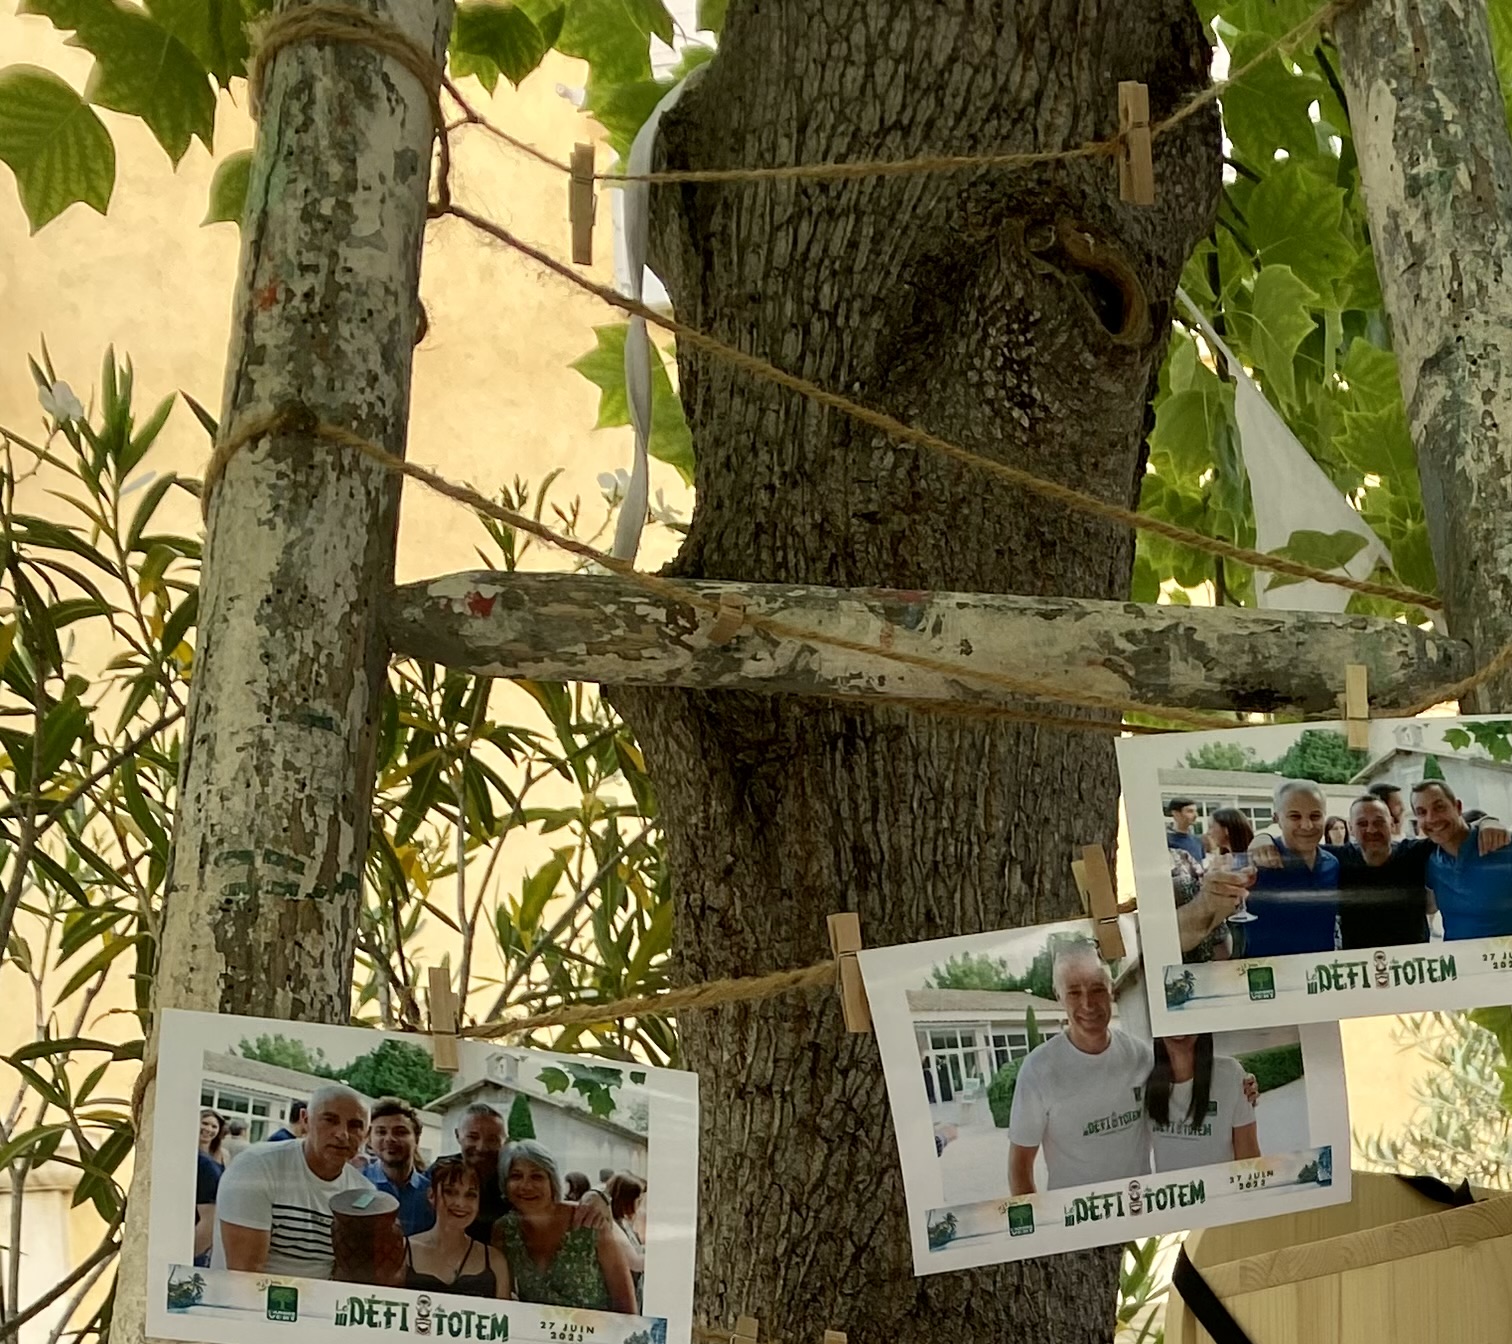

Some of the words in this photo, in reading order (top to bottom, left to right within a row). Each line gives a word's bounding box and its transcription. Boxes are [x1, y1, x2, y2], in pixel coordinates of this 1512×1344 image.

[1482, 953, 1496, 961] 27
[1315, 959, 1371, 993] DÉFI
[1389, 954, 1458, 987] TOTEM
[1248, 1170, 1274, 1181] JUIN
[1073, 1191, 1125, 1224] DÉFI
[1143, 1179, 1206, 1214] TOTEM
[348, 1294, 410, 1332] DÉFI
[432, 1309, 510, 1342] TOTEM
[540, 1321, 556, 1330] 27
[563, 1322, 595, 1334] JUIN
[550, 1331, 583, 1342] 2023
